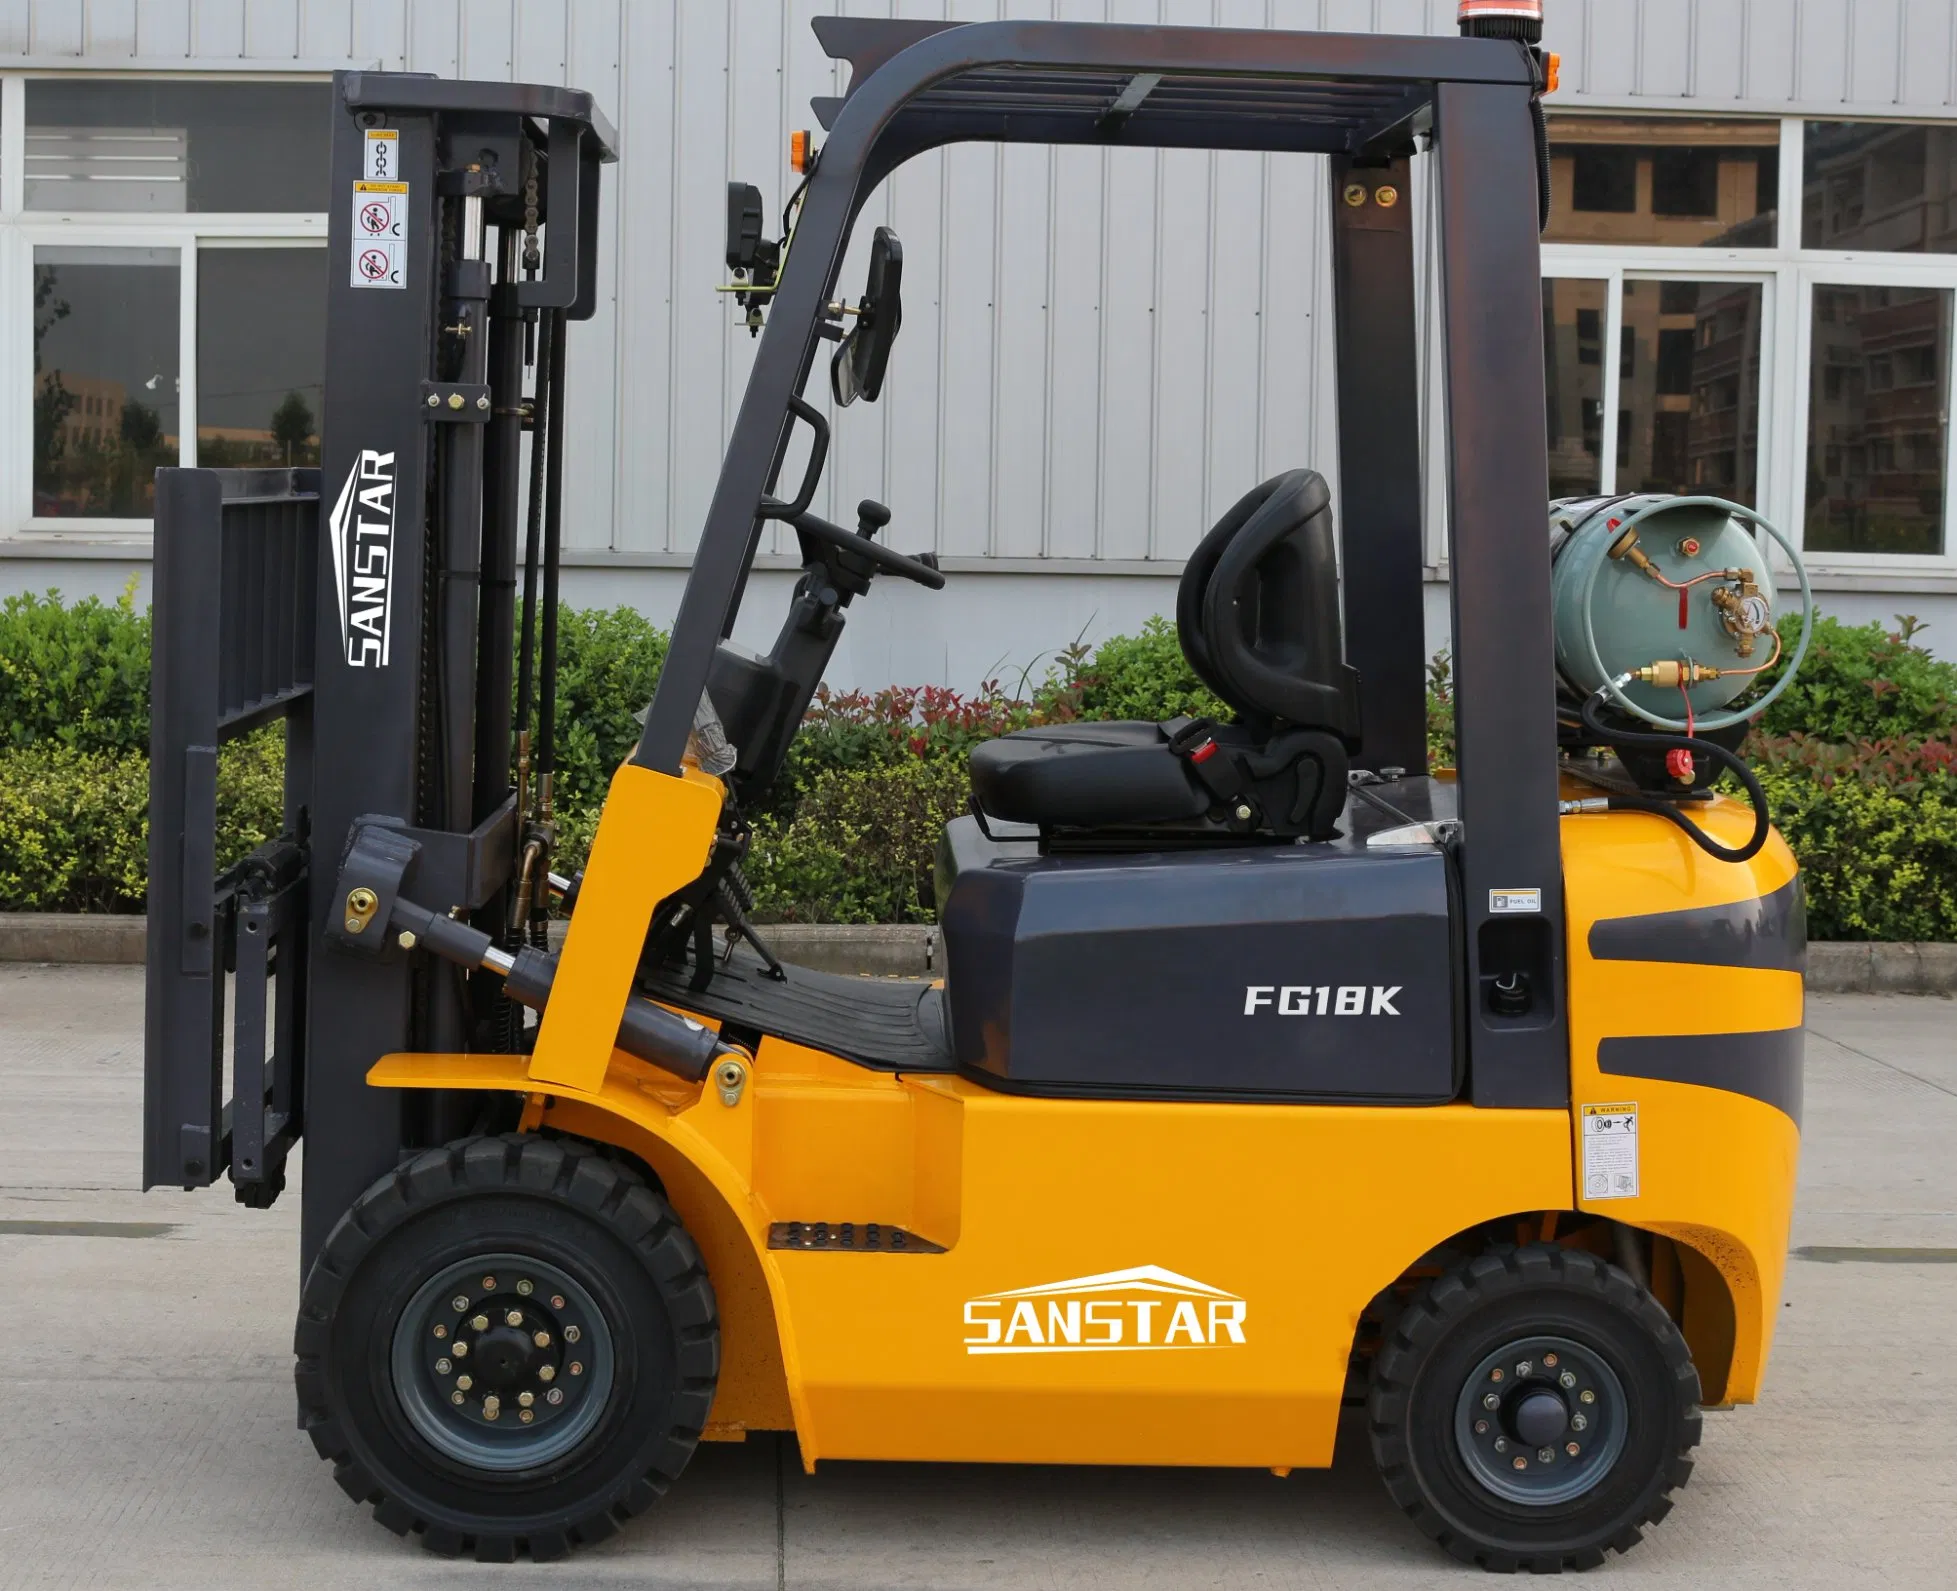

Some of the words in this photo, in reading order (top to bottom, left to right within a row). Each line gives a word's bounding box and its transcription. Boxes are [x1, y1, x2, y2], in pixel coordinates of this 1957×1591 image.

[348, 449, 395, 668] SANSTAR
[1244, 986, 1403, 1015] FG18K
[963, 1301, 1247, 1344] SANSTAR
